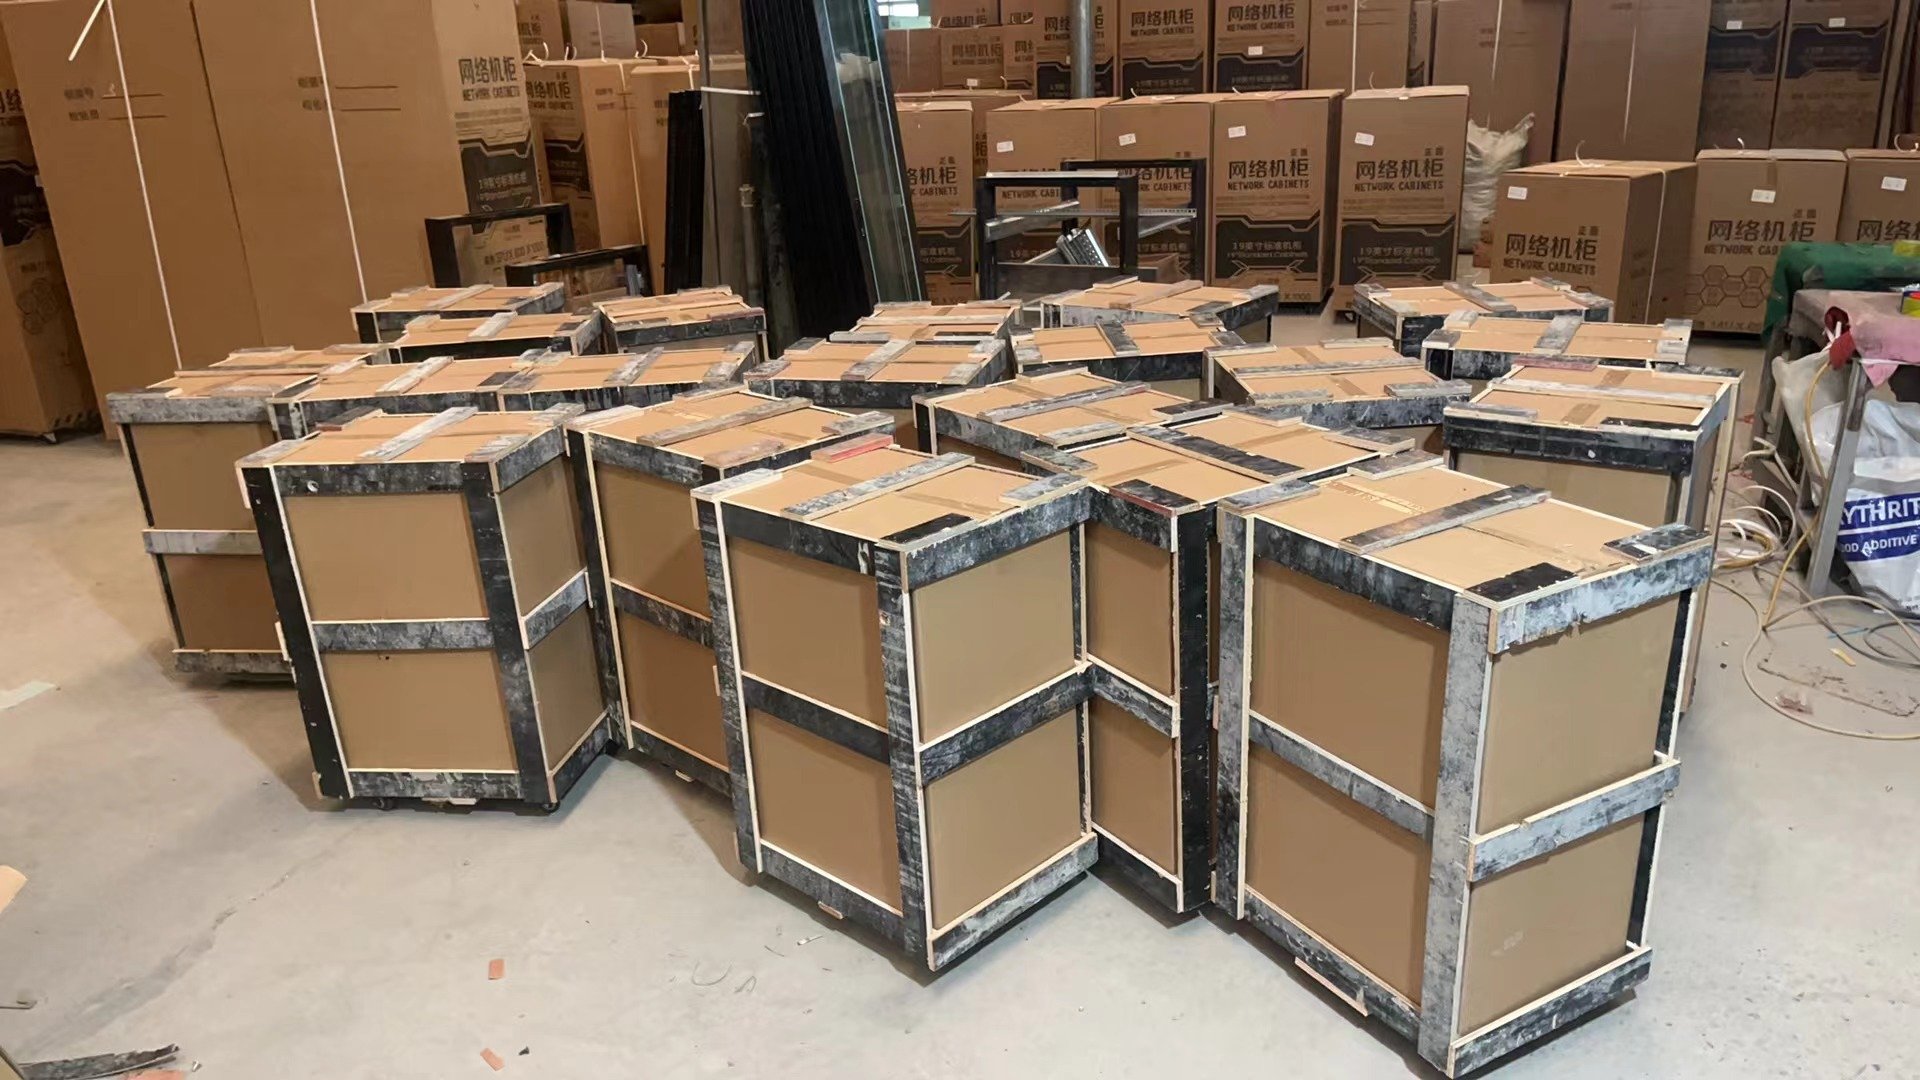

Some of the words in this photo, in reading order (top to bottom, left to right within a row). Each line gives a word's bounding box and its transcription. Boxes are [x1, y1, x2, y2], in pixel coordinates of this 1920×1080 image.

[1131, 9, 1194, 26] 网络机柜
[1228, 4, 1294, 21] 网络机柜
[458, 56, 517, 85] 网络机柜
[907, 167, 957, 185] 络机柜
[1228, 159, 1309, 178] 网络机柜
[1356, 159, 1444, 179] 网络机柜
[920, 187, 957, 196] CABINETS
[1228, 181, 1264, 190] NETWORK
[1268, 179, 1309, 189] CABINETS
[1355, 182, 1394, 192] NETWORK
[1398, 181, 1444, 190] CABINETS
[1002, 190, 1037, 199] NETWORK
[1040, 189, 1060, 198] CABI
[1708, 220, 1816, 241] 网络机柜
[1506, 233, 1598, 261] 网络机柜
[1704, 245, 1753, 255] NETWORK
[1503, 258, 1545, 271] NETWORK
[1548, 261, 1596, 275] CABINETS
[1841, 496, 1920, 526] YTHRIT
[1862, 534, 1918, 551] ADDITIVE
